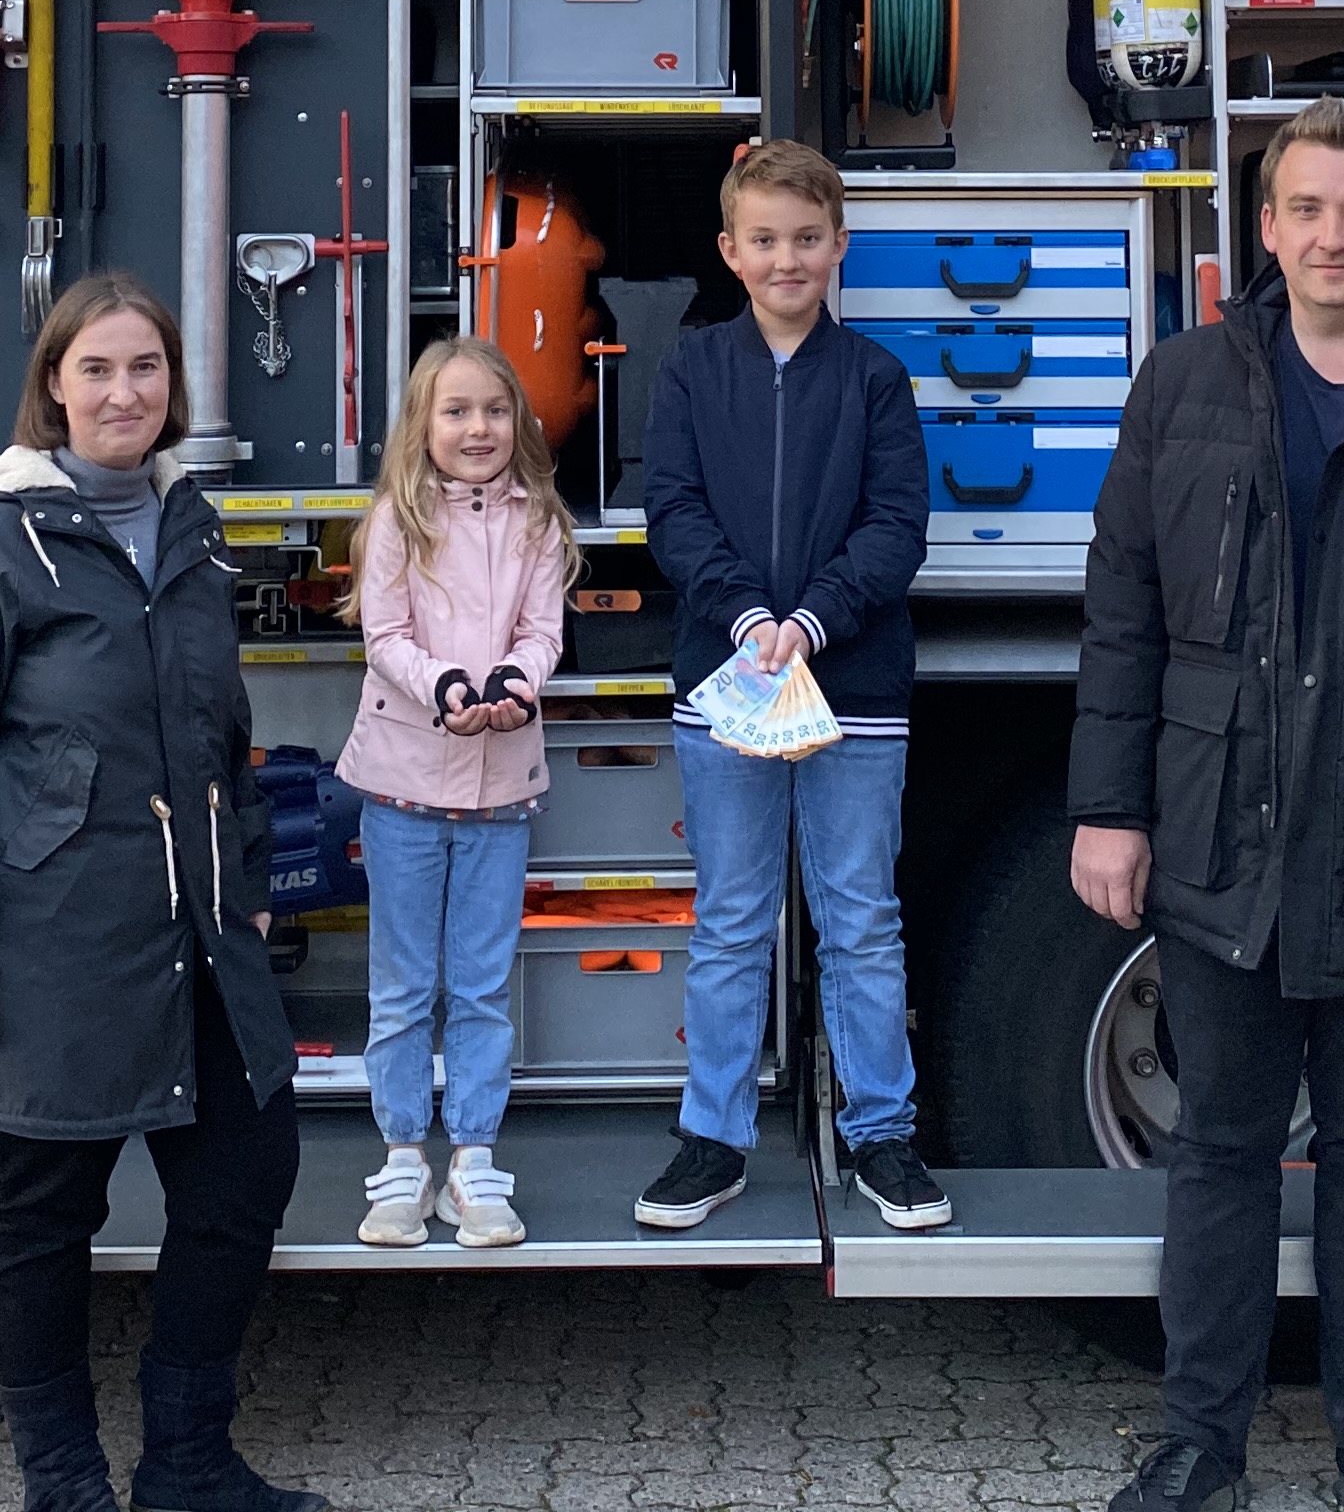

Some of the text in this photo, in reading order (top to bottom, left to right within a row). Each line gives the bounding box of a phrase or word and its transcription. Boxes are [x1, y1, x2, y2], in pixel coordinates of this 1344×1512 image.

[711, 671, 733, 694] 20
[722, 716, 735, 730] 20
[816, 720, 830, 735] 50
